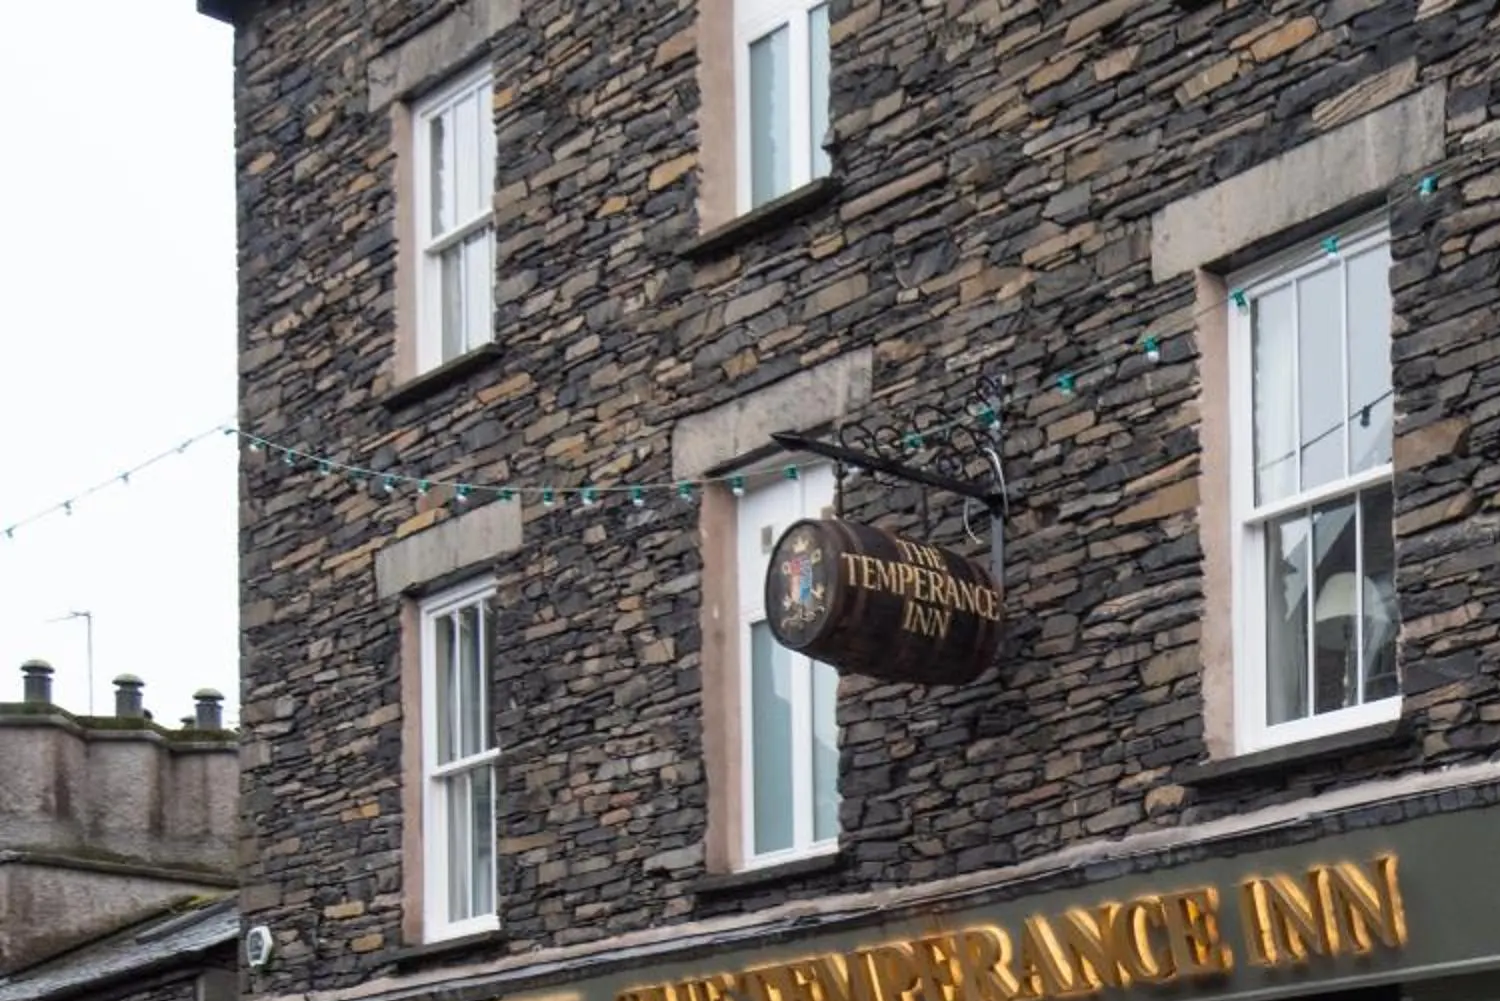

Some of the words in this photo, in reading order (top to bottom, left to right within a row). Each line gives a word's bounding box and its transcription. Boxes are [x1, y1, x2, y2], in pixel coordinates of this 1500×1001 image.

[895, 539, 948, 571] THE
[841, 552, 1000, 621] TEMPERANCE
[902, 600, 951, 639] INN
[1236, 850, 1408, 968] INN
